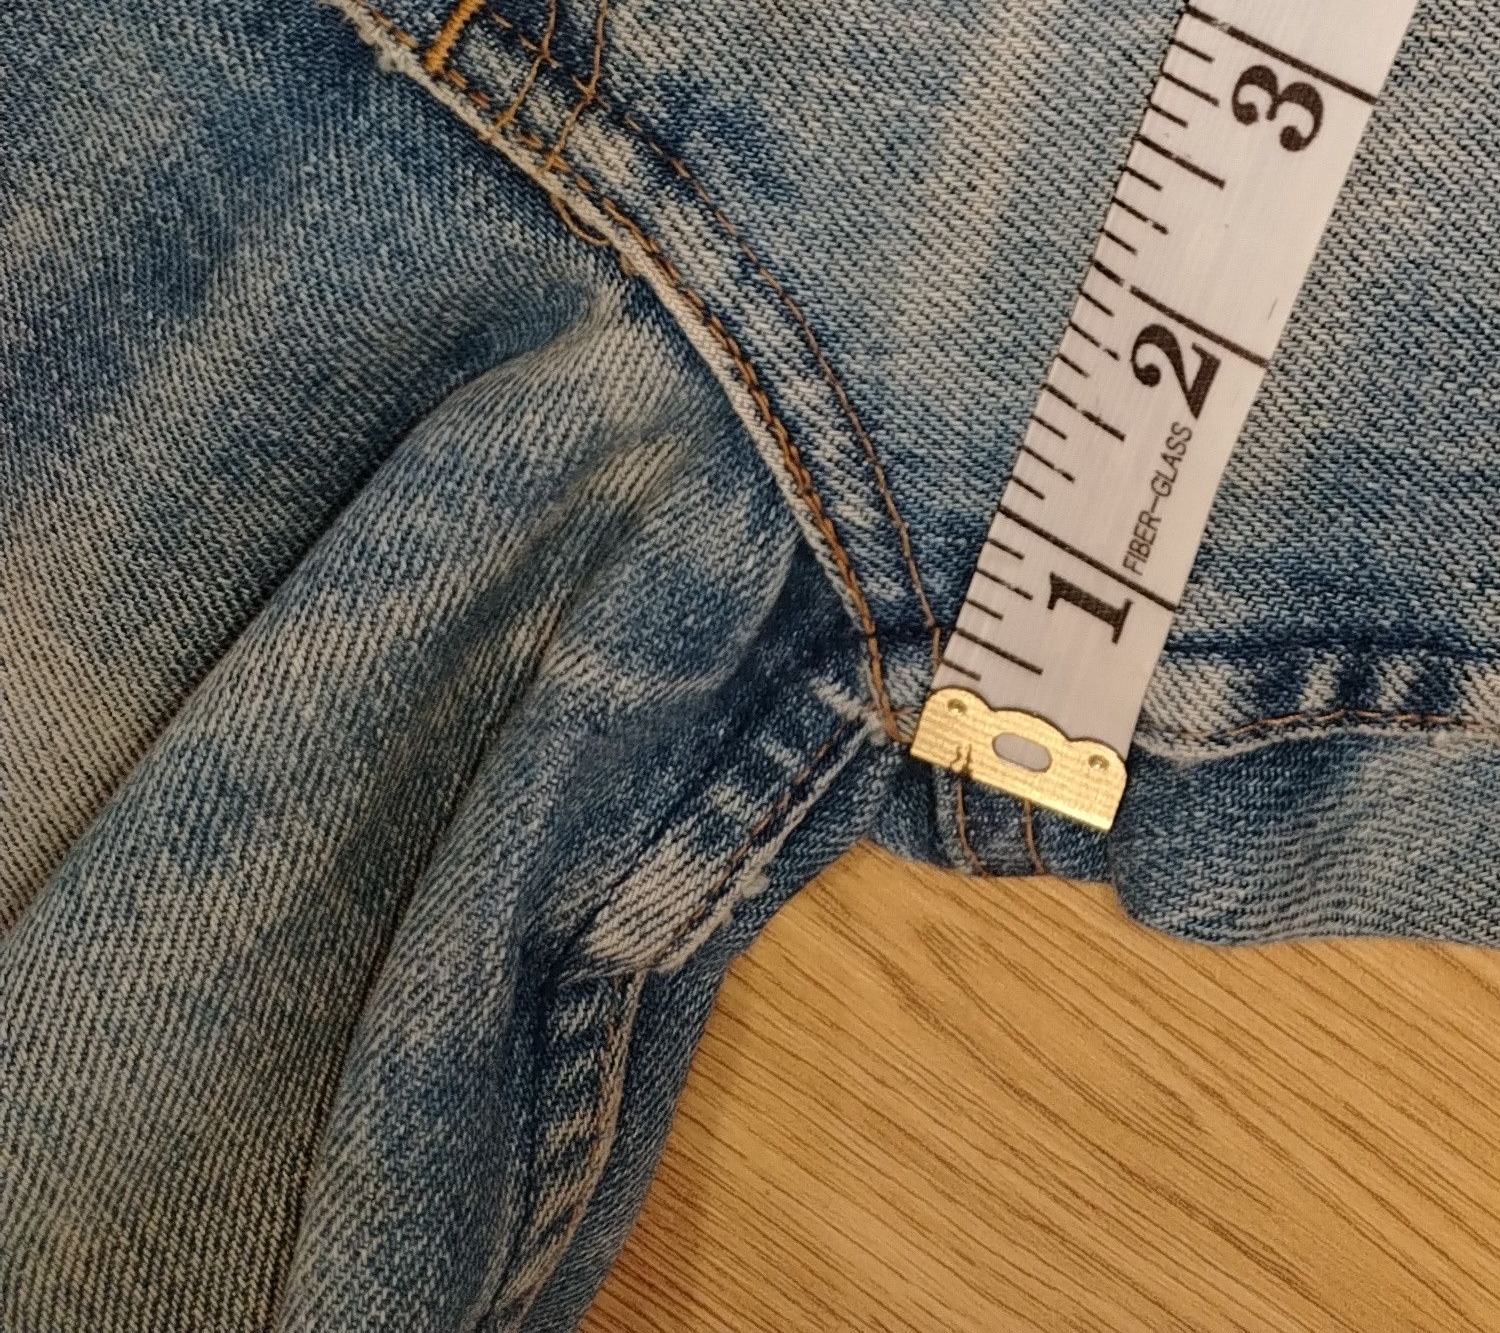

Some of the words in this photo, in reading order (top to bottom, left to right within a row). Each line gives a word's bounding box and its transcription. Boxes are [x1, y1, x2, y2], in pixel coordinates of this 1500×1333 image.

[1231, 64, 1325, 153] 3
[1130, 323, 1221, 418] 2
[1047, 572, 1132, 645] 1
